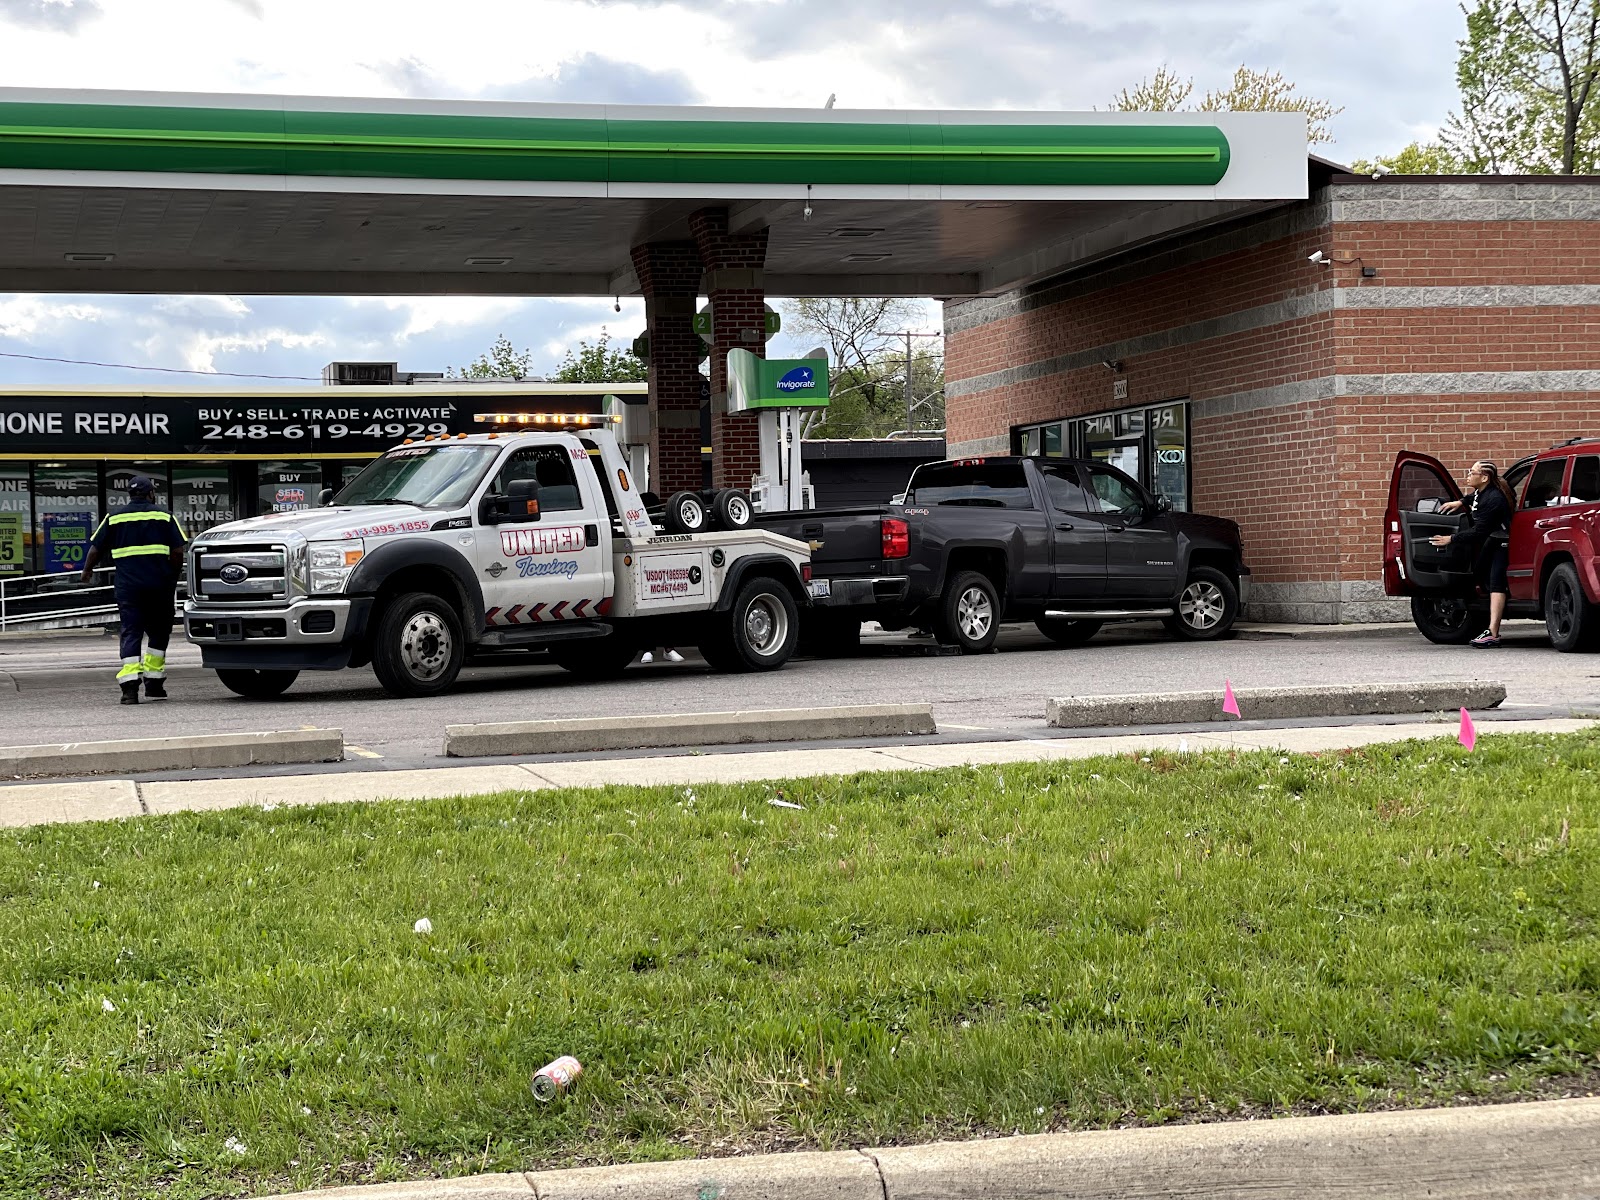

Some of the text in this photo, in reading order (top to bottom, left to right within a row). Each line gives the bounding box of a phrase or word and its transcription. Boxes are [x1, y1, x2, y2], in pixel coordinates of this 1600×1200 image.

[697, 317, 706, 328] 2
[770, 316, 775, 328] 1
[776, 379, 816, 390] Invigorate
[198, 407, 451, 421] BUY SELL TRADE ACTIVATE
[0, 412, 170, 435] ONE REPAIR
[202, 422, 448, 440] 248-619-4929
[279, 474, 301, 482] BUY
[54, 480, 78, 490] WE
[192, 480, 214, 489] WE
[37, 495, 98, 506] UNLOCK
[188, 494, 218, 505] BUY
[272, 503, 310, 512] REPAIR
[175, 510, 234, 521] PHONES
[343, 520, 430, 538] 313-995-1855
[500, 525, 586, 557] UNITED
[54, 545, 84, 562] $20
[515, 556, 578, 580] Towing
